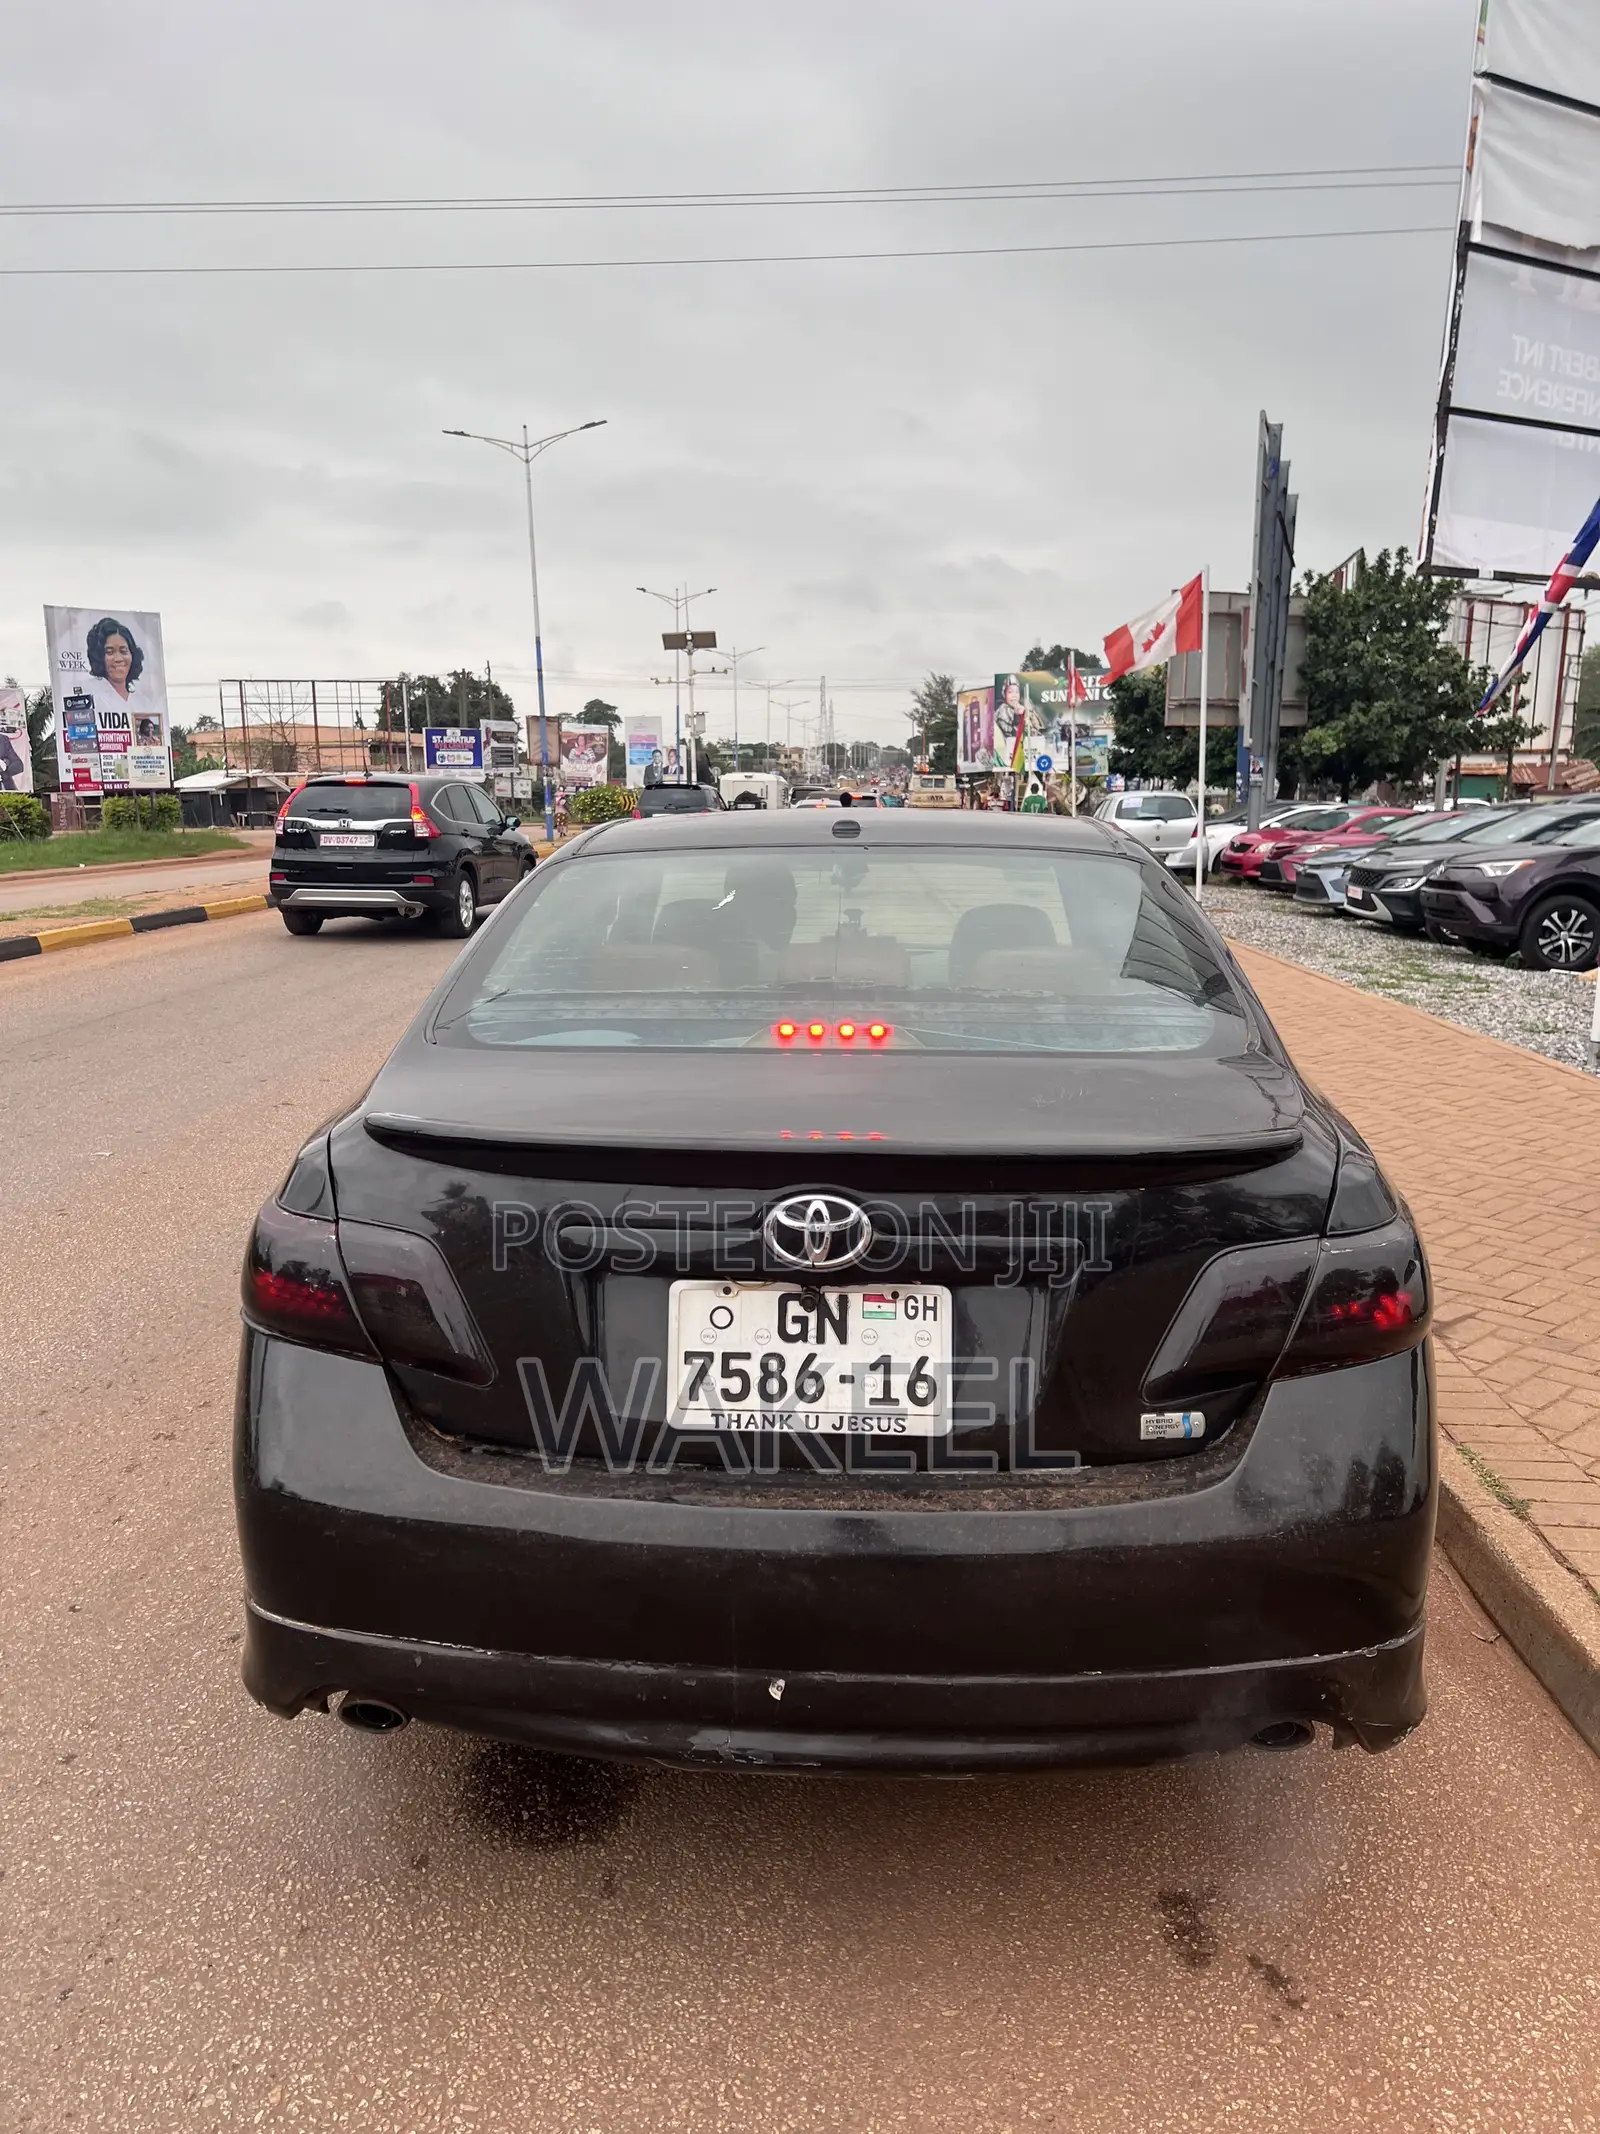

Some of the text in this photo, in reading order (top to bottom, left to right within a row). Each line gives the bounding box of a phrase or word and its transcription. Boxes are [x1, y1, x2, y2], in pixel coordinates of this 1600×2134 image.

[59, 660, 87, 669] WEEK
[61, 651, 83, 660] ONE
[98, 712, 130, 729] VIDA
[777, 1292, 938, 1345] GN GH
[684, 1351, 938, 1407] 7586-16
[711, 1413, 907, 1433] THANK U JESUS
